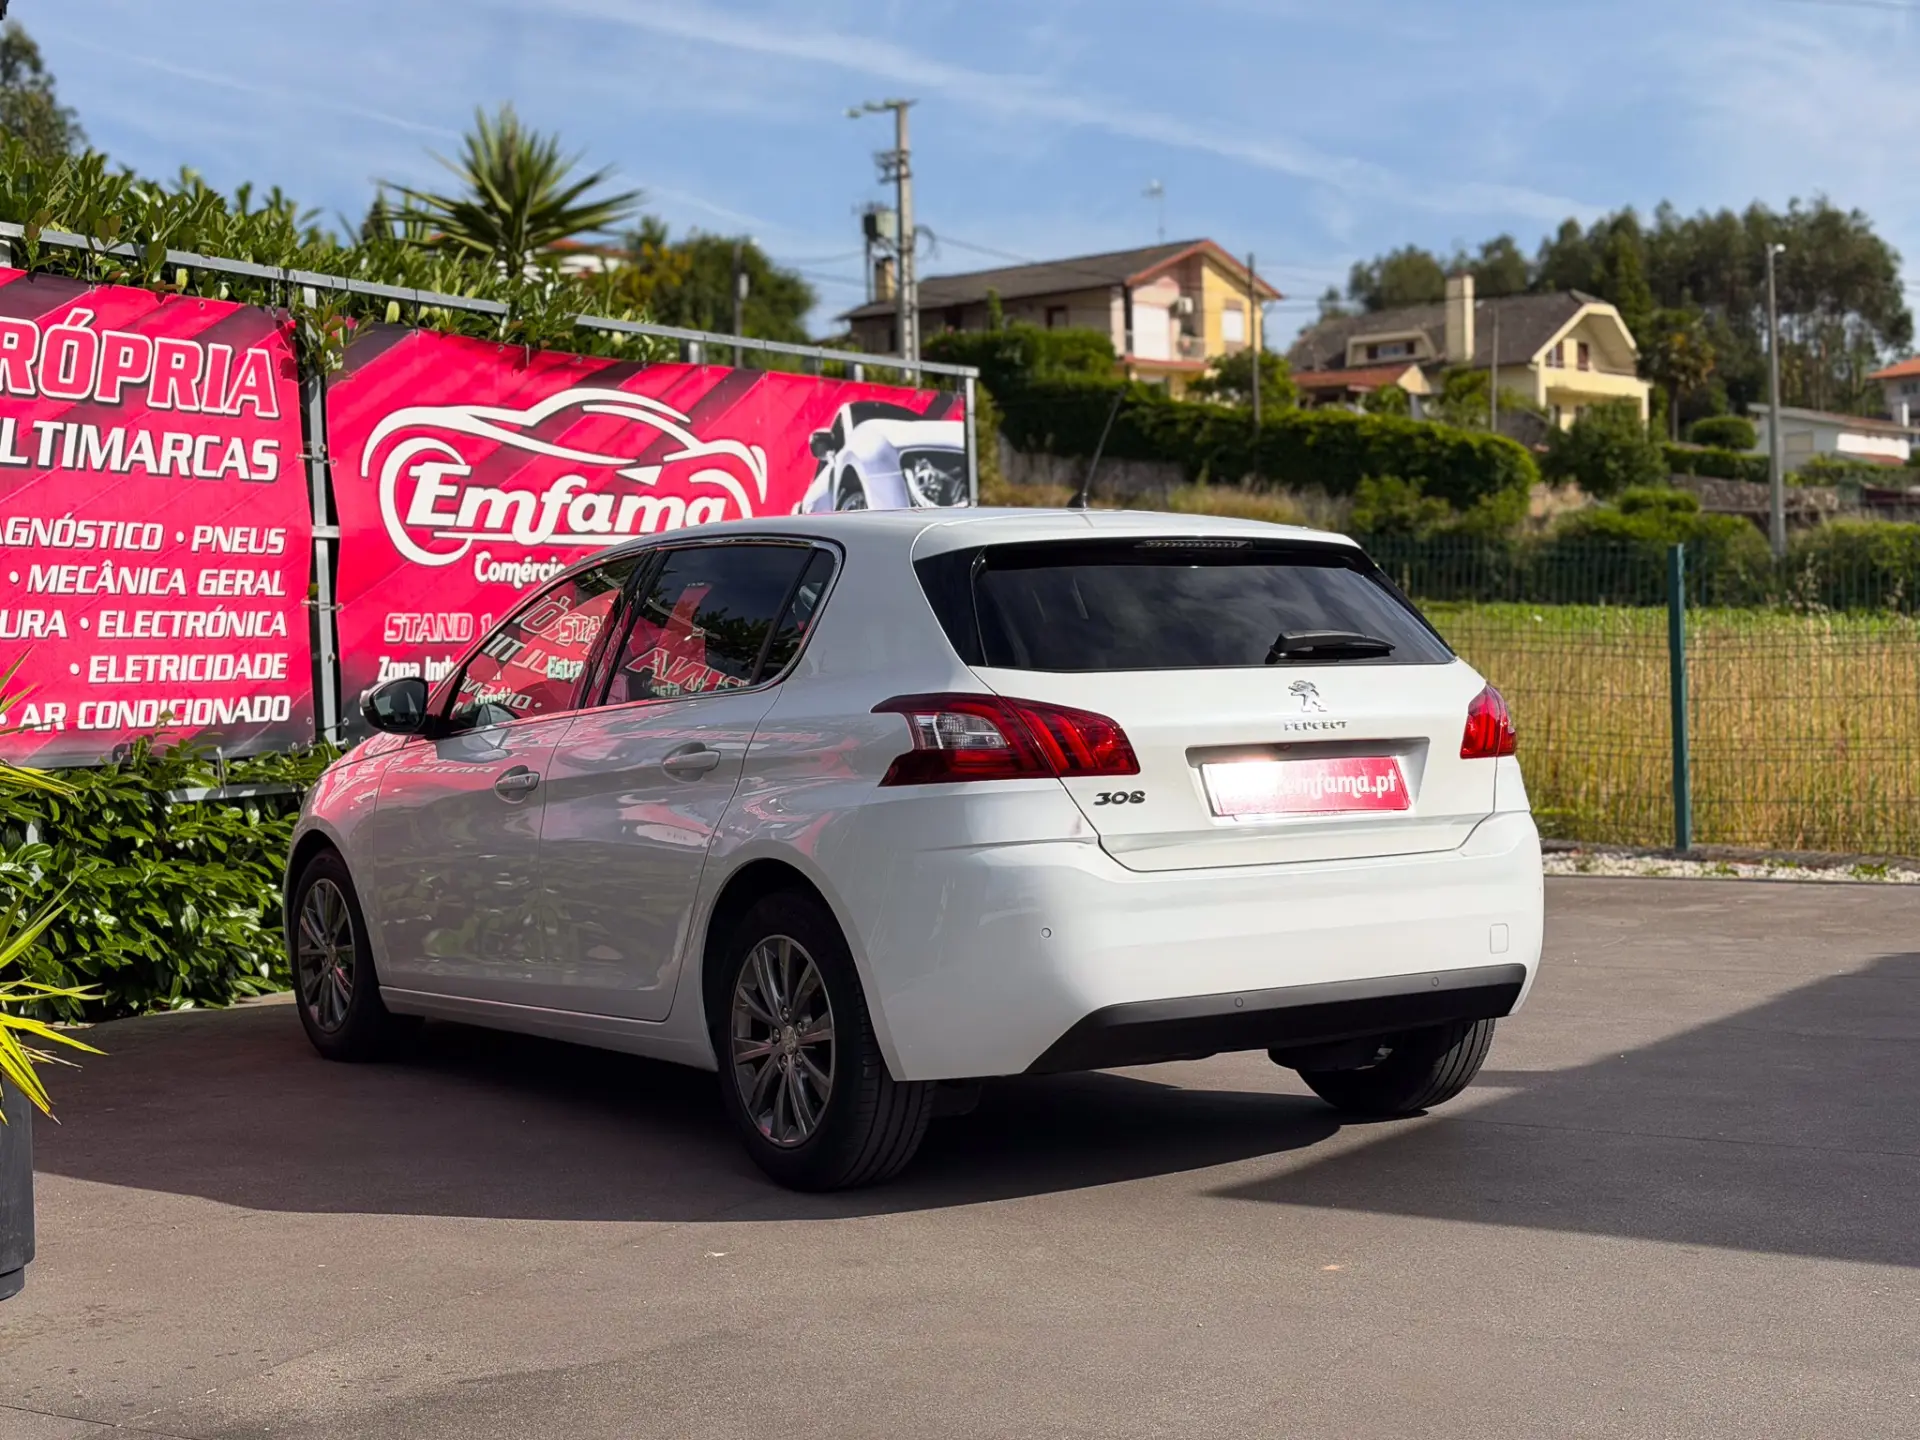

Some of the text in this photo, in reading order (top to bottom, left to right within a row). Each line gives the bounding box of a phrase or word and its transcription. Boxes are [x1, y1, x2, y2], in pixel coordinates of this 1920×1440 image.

[405, 460, 727, 545] Emfama
[190, 525, 286, 554] PNEUS
[27, 559, 286, 597] MECÂNICA GERAL
[97, 604, 288, 638] ELECTRÓNICA
[384, 612, 474, 643] STAND
[88, 652, 288, 683] ELETRICIDADE
[377, 655, 421, 683] Zona
[424, 655, 456, 682] Ind
[19, 702, 67, 731] AR
[1093, 790, 1146, 806] 308
